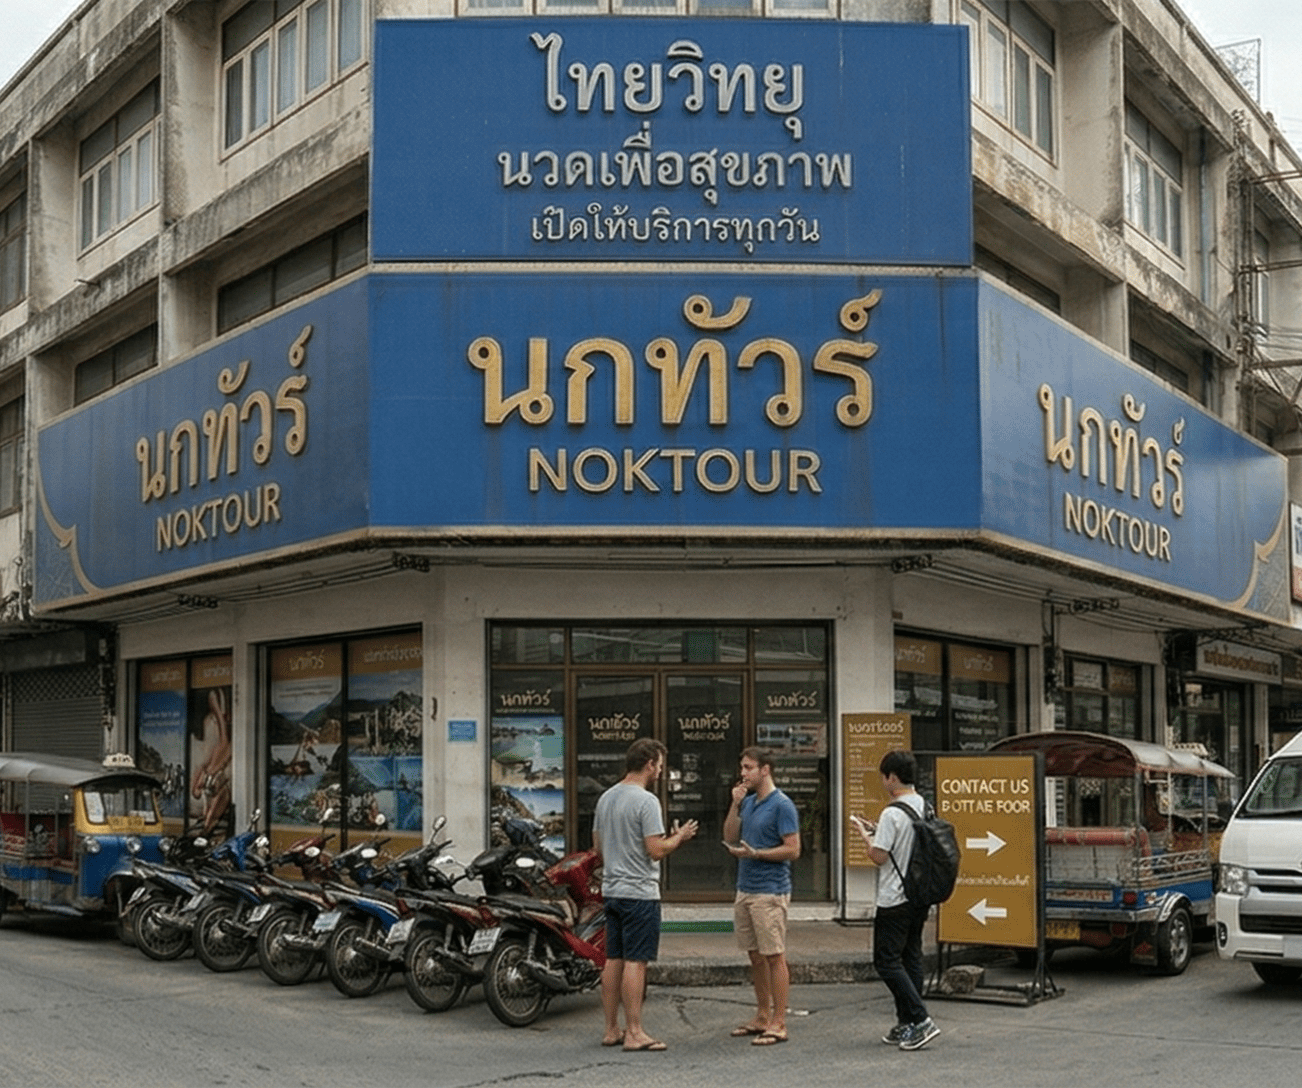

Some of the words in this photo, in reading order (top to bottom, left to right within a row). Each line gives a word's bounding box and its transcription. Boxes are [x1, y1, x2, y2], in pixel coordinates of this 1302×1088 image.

[530, 32, 804, 139] ไทยวิทยุ
[498, 121, 853, 205] นวดเพื่อสุขภาพ
[467, 289, 883, 427] นกทัวร์
[136, 324, 314, 503] นกทัวร์
[1039, 383, 1185, 516] นกทัวร์
[529, 447, 823, 493] NOKTOUR
[157, 482, 281, 552] NOKTOUR
[1065, 492, 1172, 561] NOKTOUR
[941, 779, 1007, 795] CONTACT
[1010, 779, 1030, 795] US
